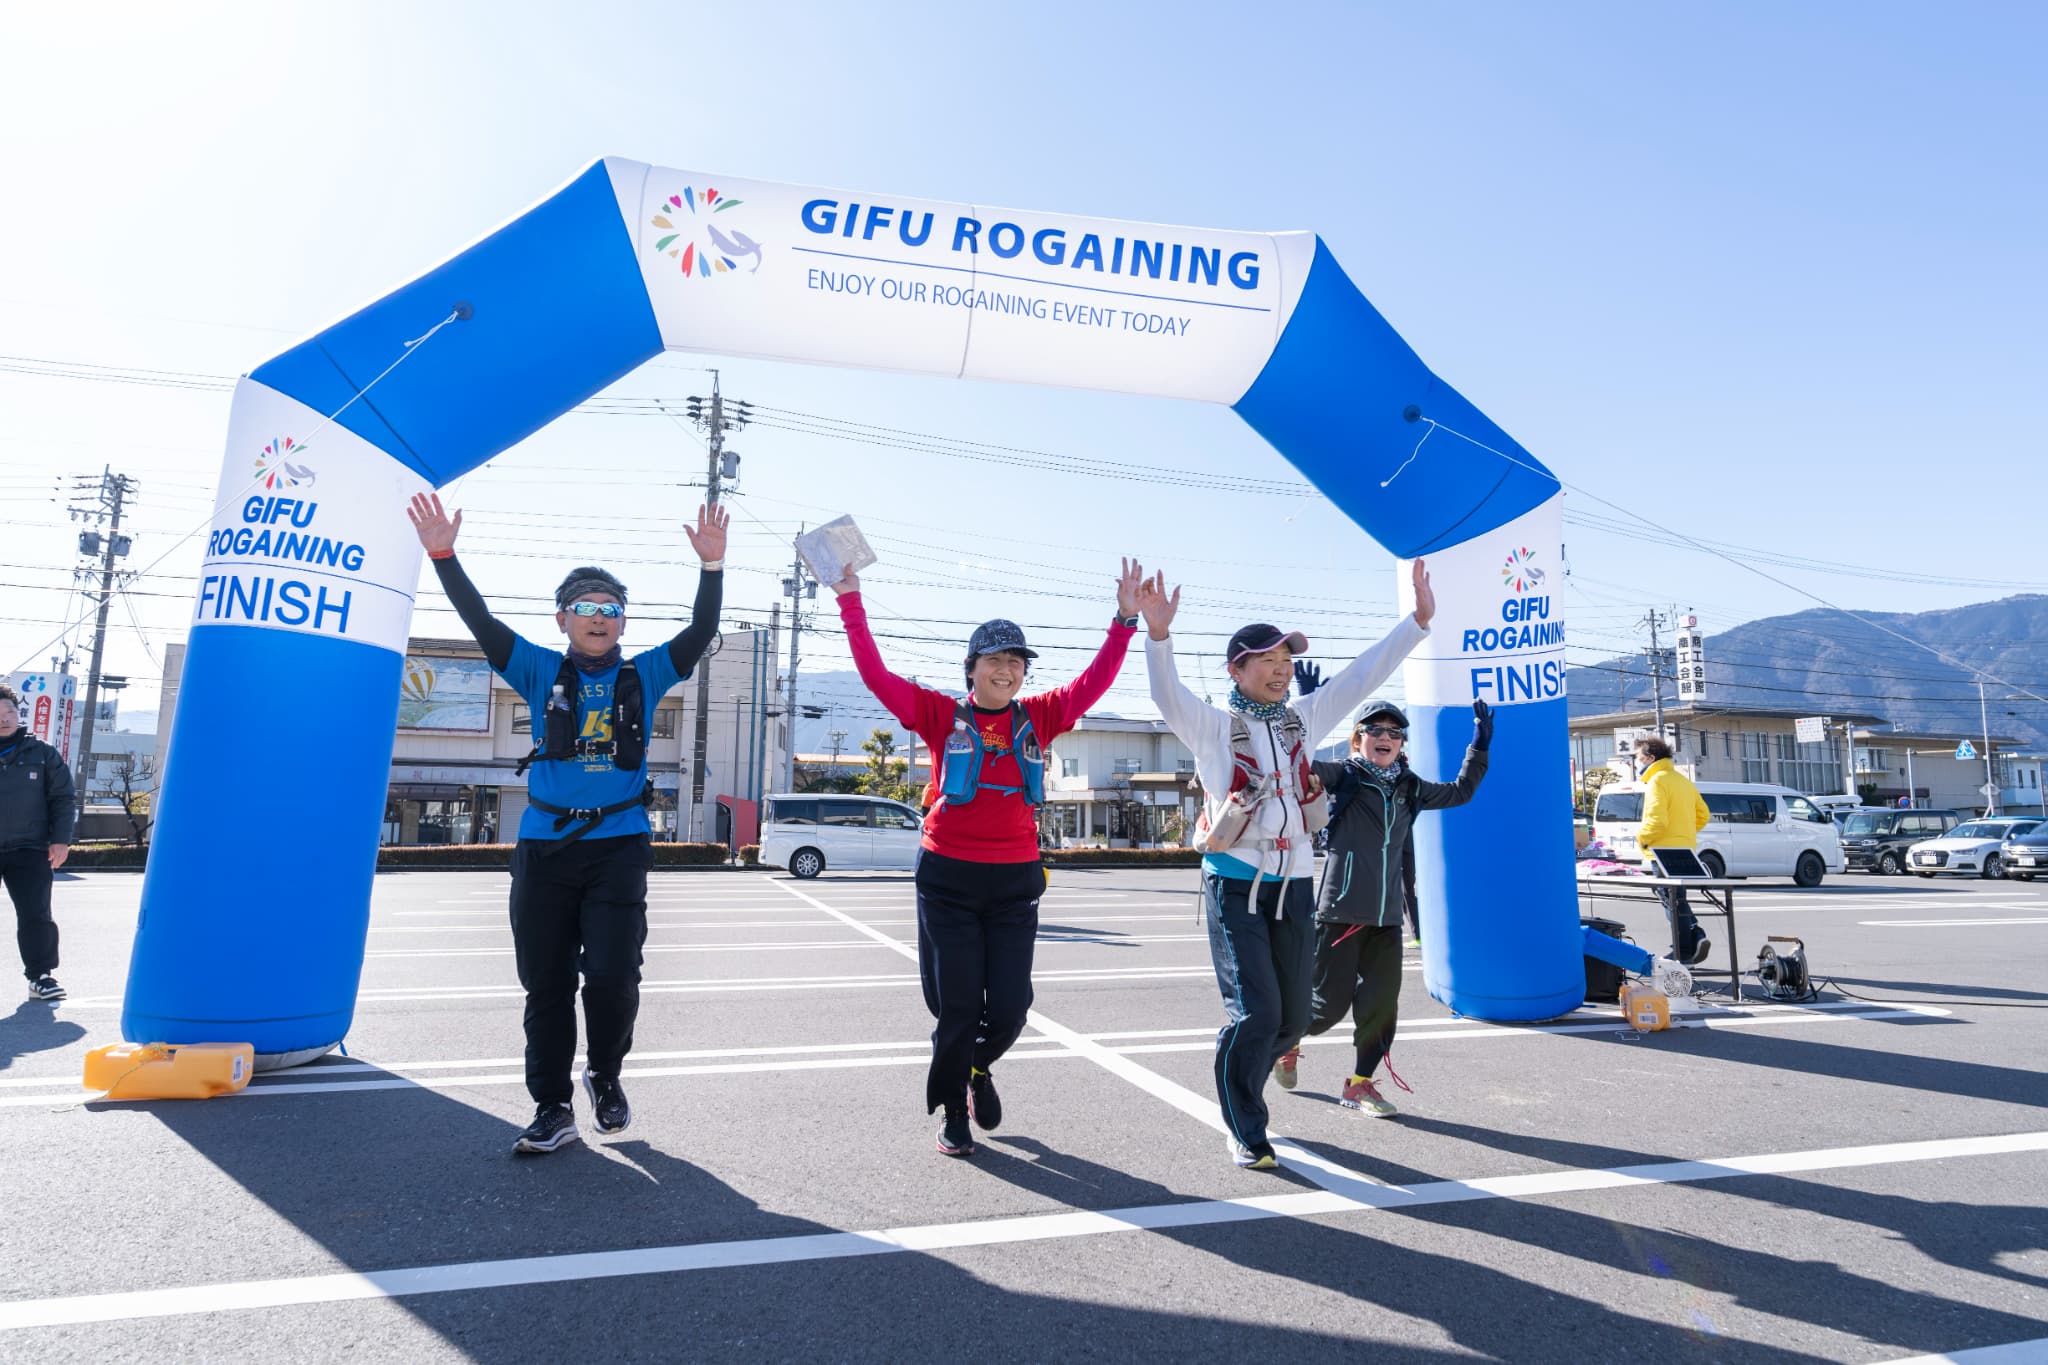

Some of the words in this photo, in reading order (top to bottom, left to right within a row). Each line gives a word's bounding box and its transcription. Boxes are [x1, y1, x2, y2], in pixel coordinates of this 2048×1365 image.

[801, 198, 934, 247] GIFU
[952, 217, 1260, 291] ROGAINING
[808, 268, 875, 297] ENJOY
[881, 275, 927, 303] OUR
[932, 284, 1046, 322] ROGAINING
[1053, 302, 1116, 329] EVENT
[1122, 311, 1191, 337] TODAY
[242, 495, 317, 528] GIFU
[207, 528, 365, 571] ROGAINING
[198, 576, 352, 633] FINISH
[1502, 595, 1550, 622] GIFU
